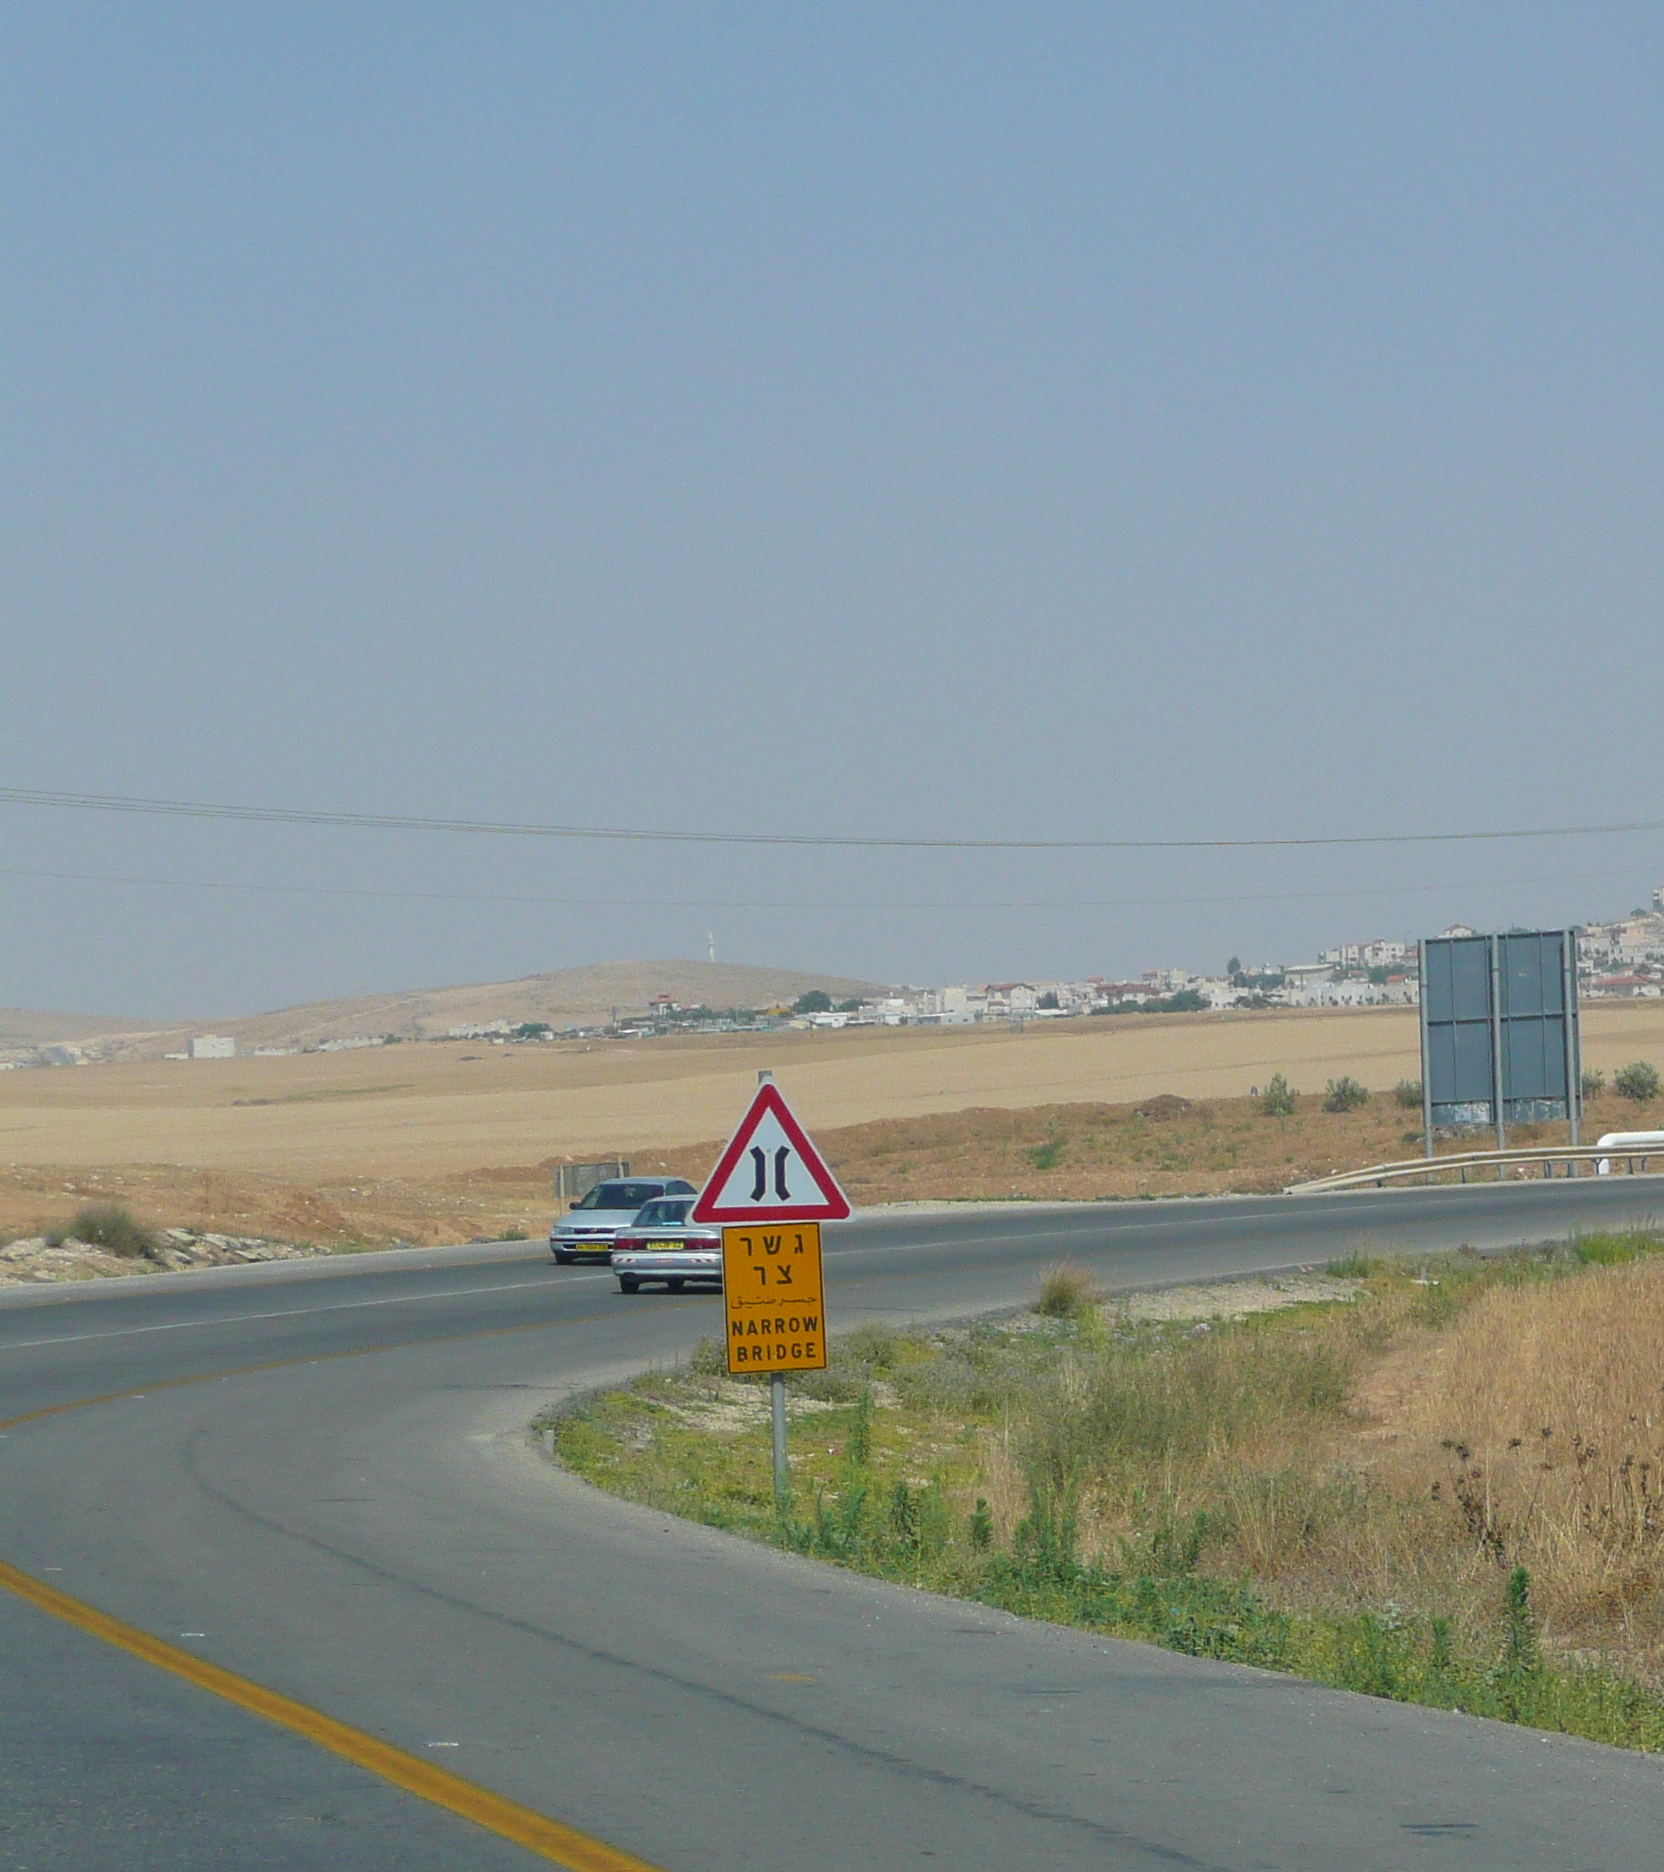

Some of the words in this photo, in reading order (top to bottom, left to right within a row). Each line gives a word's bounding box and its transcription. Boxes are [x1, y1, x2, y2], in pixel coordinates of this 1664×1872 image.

[739, 1233, 804, 1256] גשר
[753, 1264, 793, 1286] צר
[730, 1295, 777, 1310] ضيق
[778, 1296, 818, 1307] جسر
[732, 1316, 818, 1336] NARROW
[736, 1342, 816, 1363] BRIDGE
